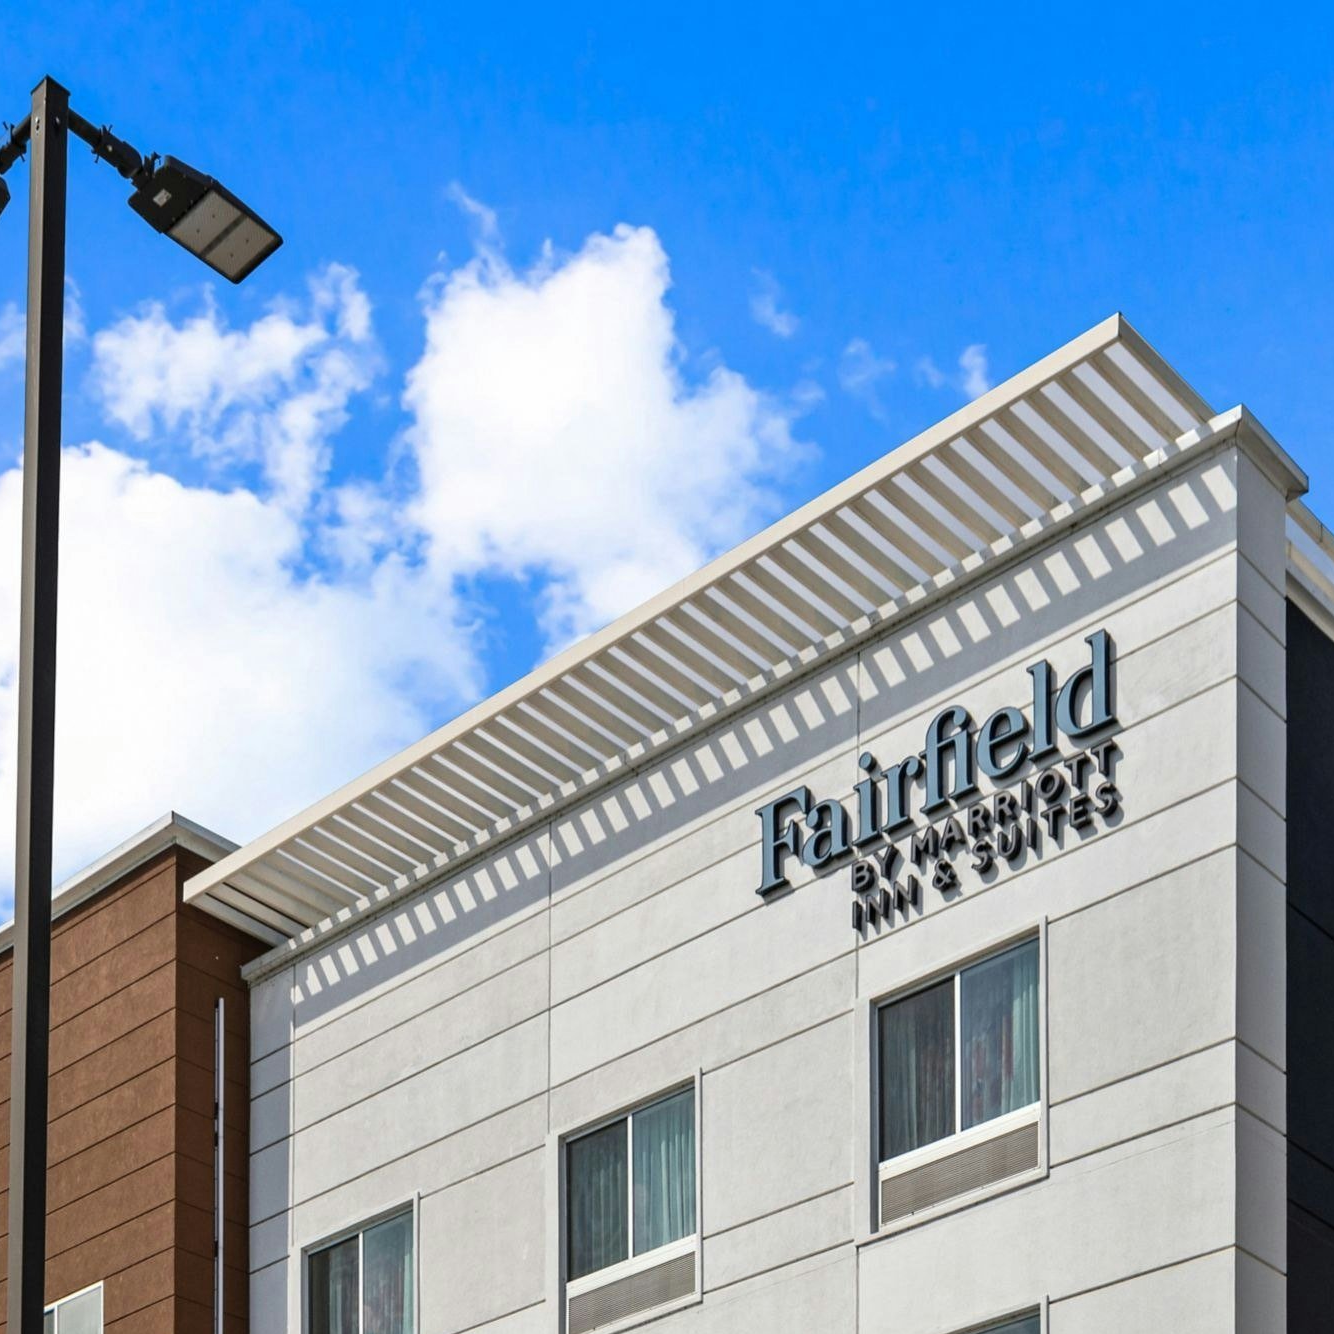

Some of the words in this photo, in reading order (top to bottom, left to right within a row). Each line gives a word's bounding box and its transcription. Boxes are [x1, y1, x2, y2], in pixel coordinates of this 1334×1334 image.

[754, 628, 1118, 897] Fairfield
[851, 845, 900, 893] BY
[910, 739, 1117, 866] MARRIOTT
[851, 874, 920, 931] INN
[931, 859, 959, 892] &
[970, 782, 1119, 875] SUITES
